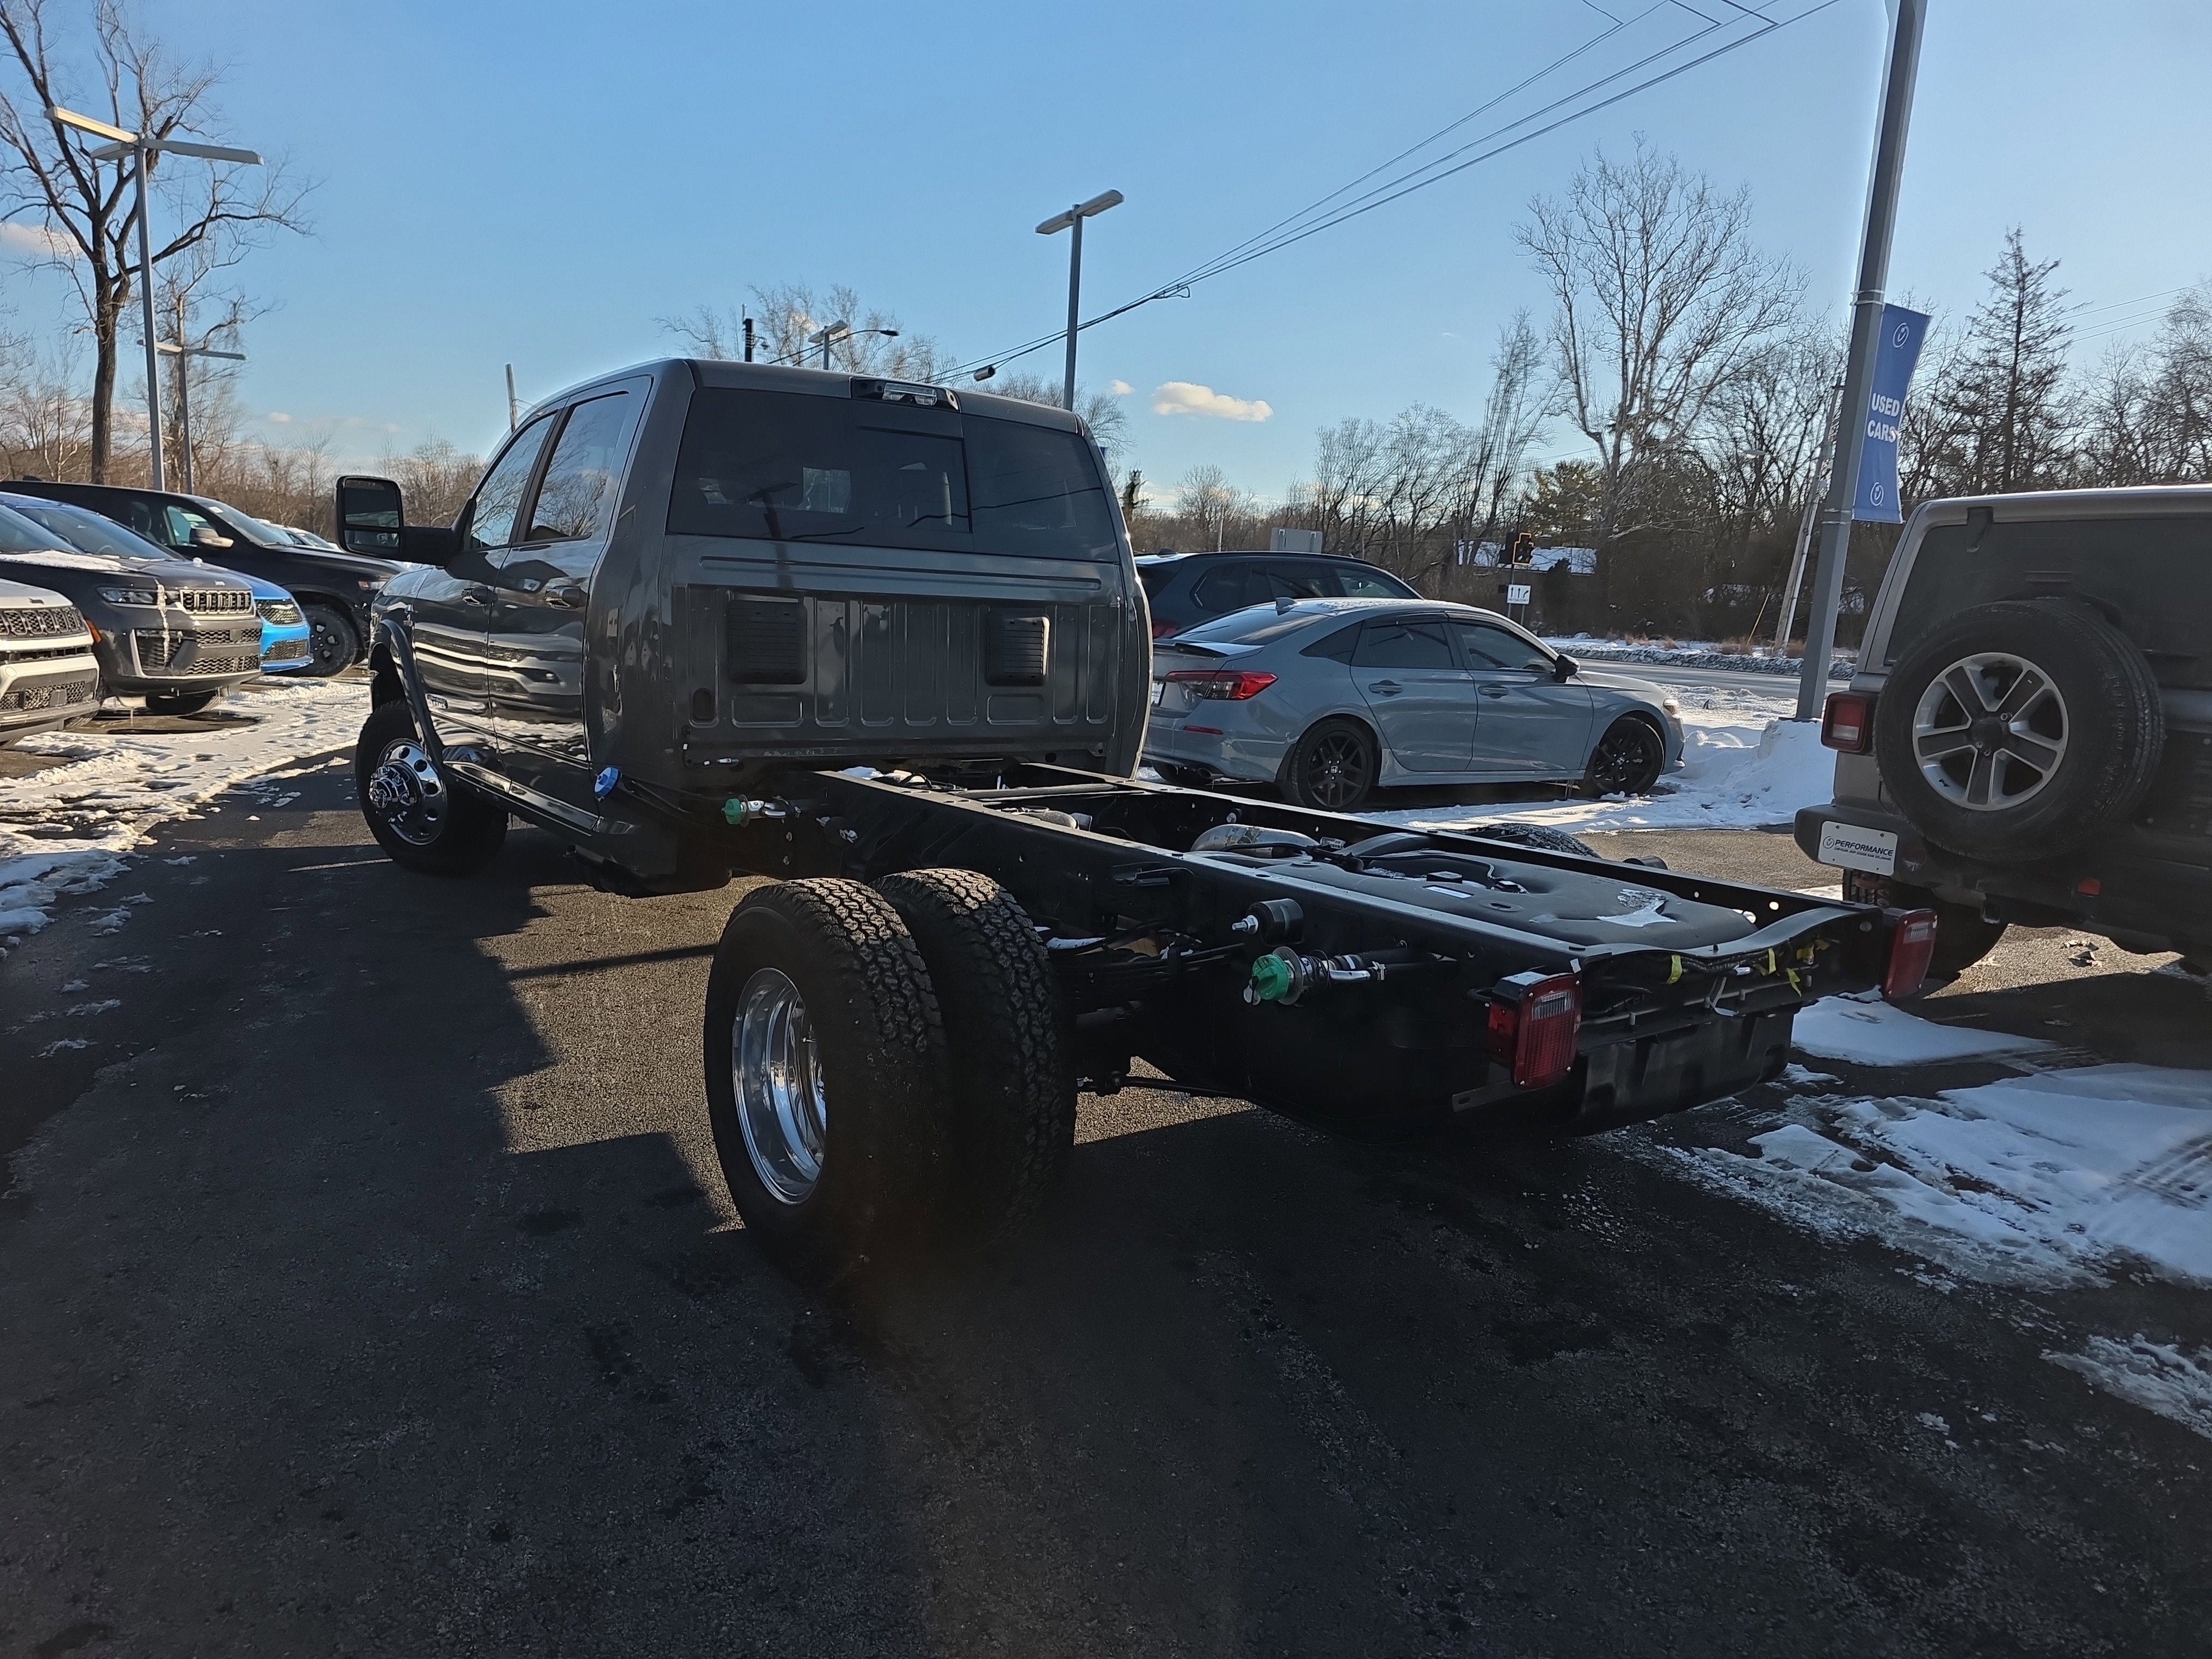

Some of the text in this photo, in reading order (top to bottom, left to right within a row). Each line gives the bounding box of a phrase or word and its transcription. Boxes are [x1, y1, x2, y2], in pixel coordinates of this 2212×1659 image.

[1872, 393, 1900, 417] USED
[1867, 420, 1896, 443] CARS
[1835, 839, 1894, 856] PERFORMANCE
